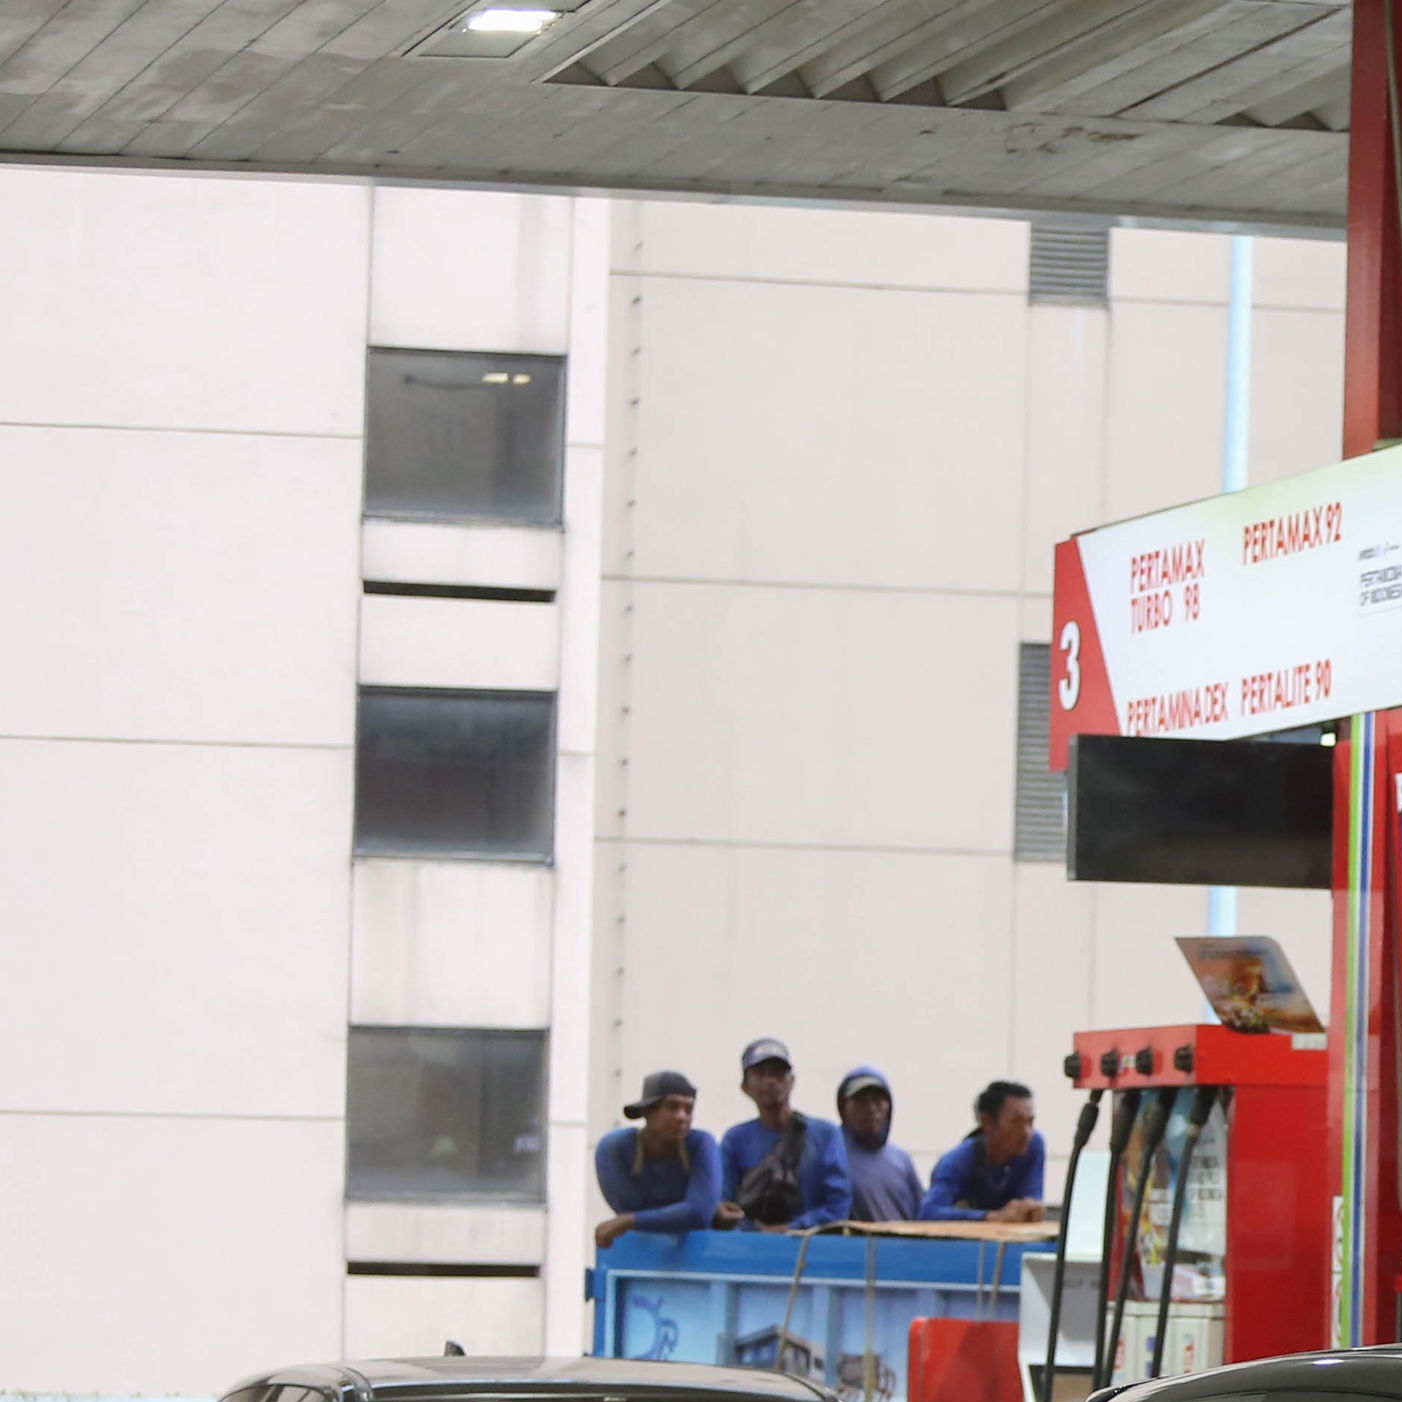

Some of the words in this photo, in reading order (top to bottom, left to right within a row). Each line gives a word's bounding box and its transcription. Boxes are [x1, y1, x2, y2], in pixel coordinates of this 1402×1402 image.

[1243, 504, 1323, 565] PERTAMAX
[1325, 502, 1342, 543] 92
[1130, 538, 1205, 594] PERTAMAX
[1131, 590, 1172, 634] TURBO
[1184, 583, 1200, 621] 98
[1059, 621, 1080, 710] 3
[1241, 663, 1310, 716] PERTALITE
[1316, 658, 1332, 700] 90
[1127, 688, 1201, 737] PERTAMINA
[1204, 682, 1228, 724] DEX
